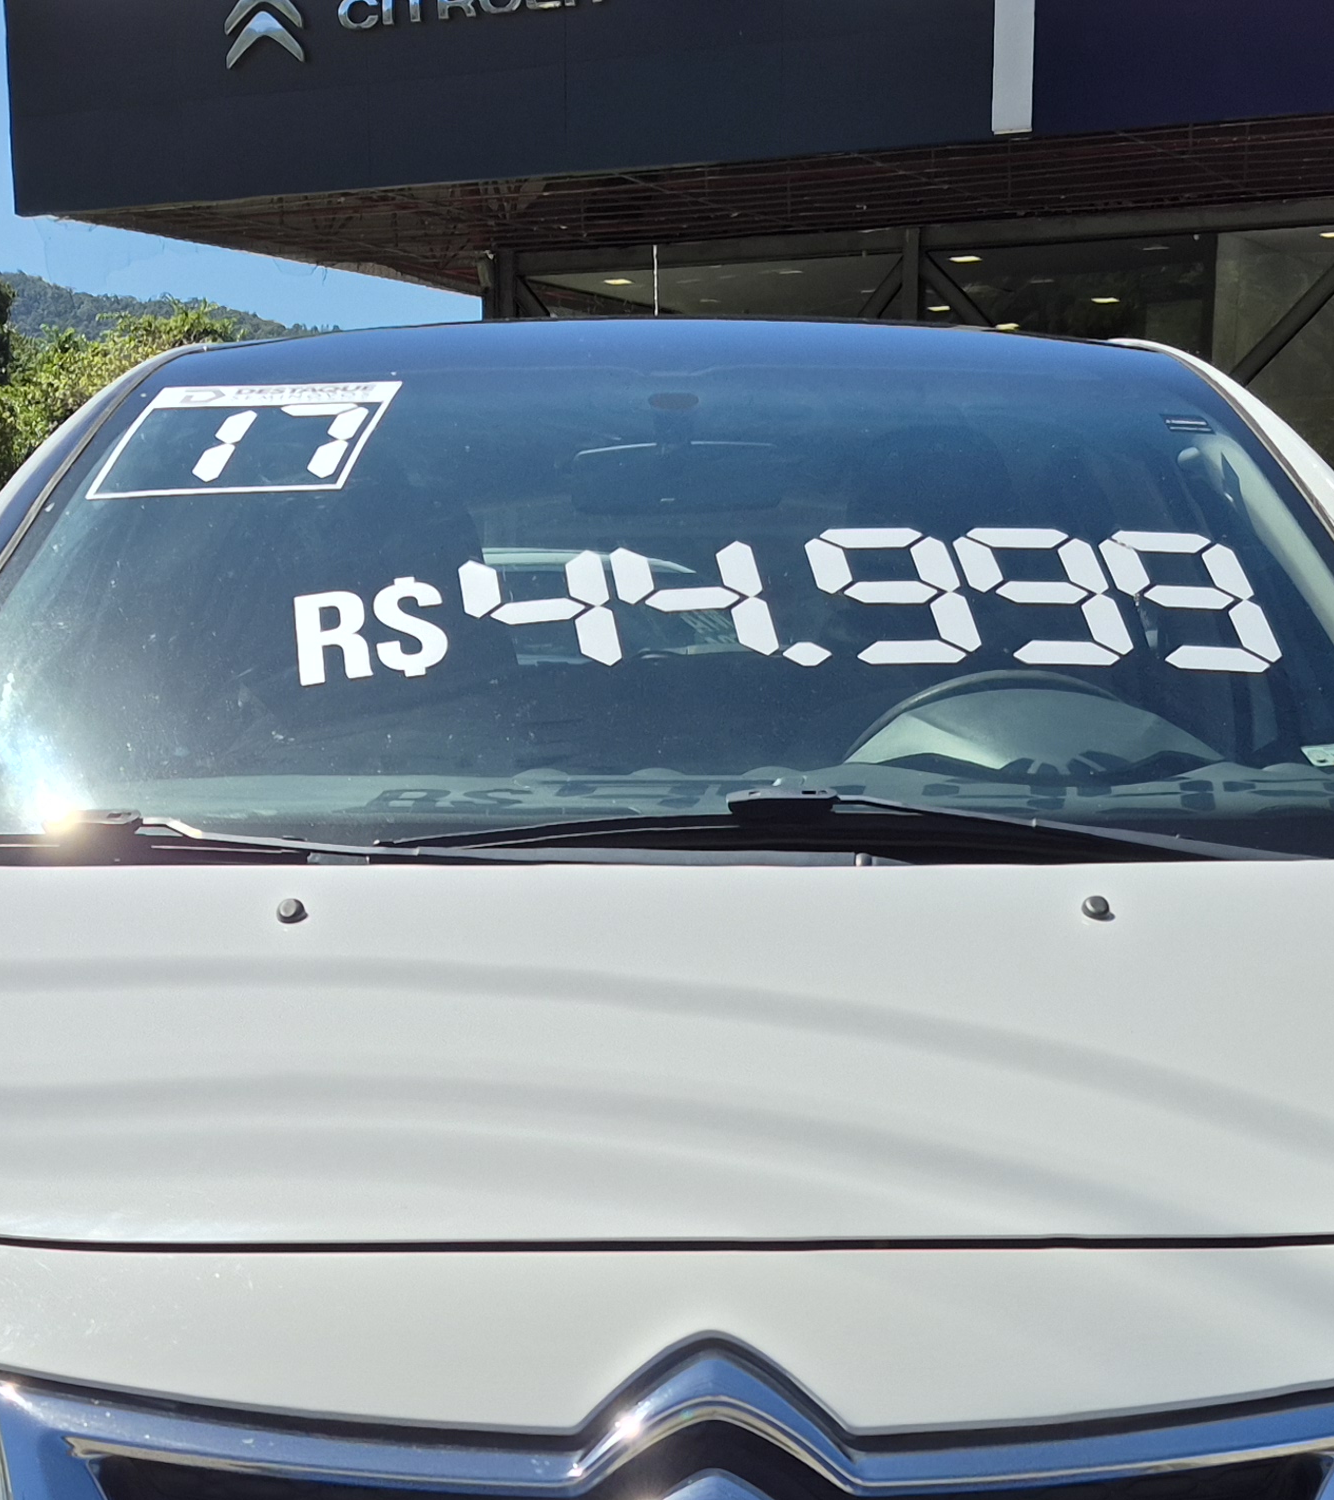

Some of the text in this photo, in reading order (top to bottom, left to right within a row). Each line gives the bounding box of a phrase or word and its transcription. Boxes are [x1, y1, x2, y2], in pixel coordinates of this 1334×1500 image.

[338, 0, 603, 29] CITR
[235, 384, 375, 395] DESTAQUE
[192, 403, 369, 482] 17
[294, 527, 1283, 687] R$ 44.999
